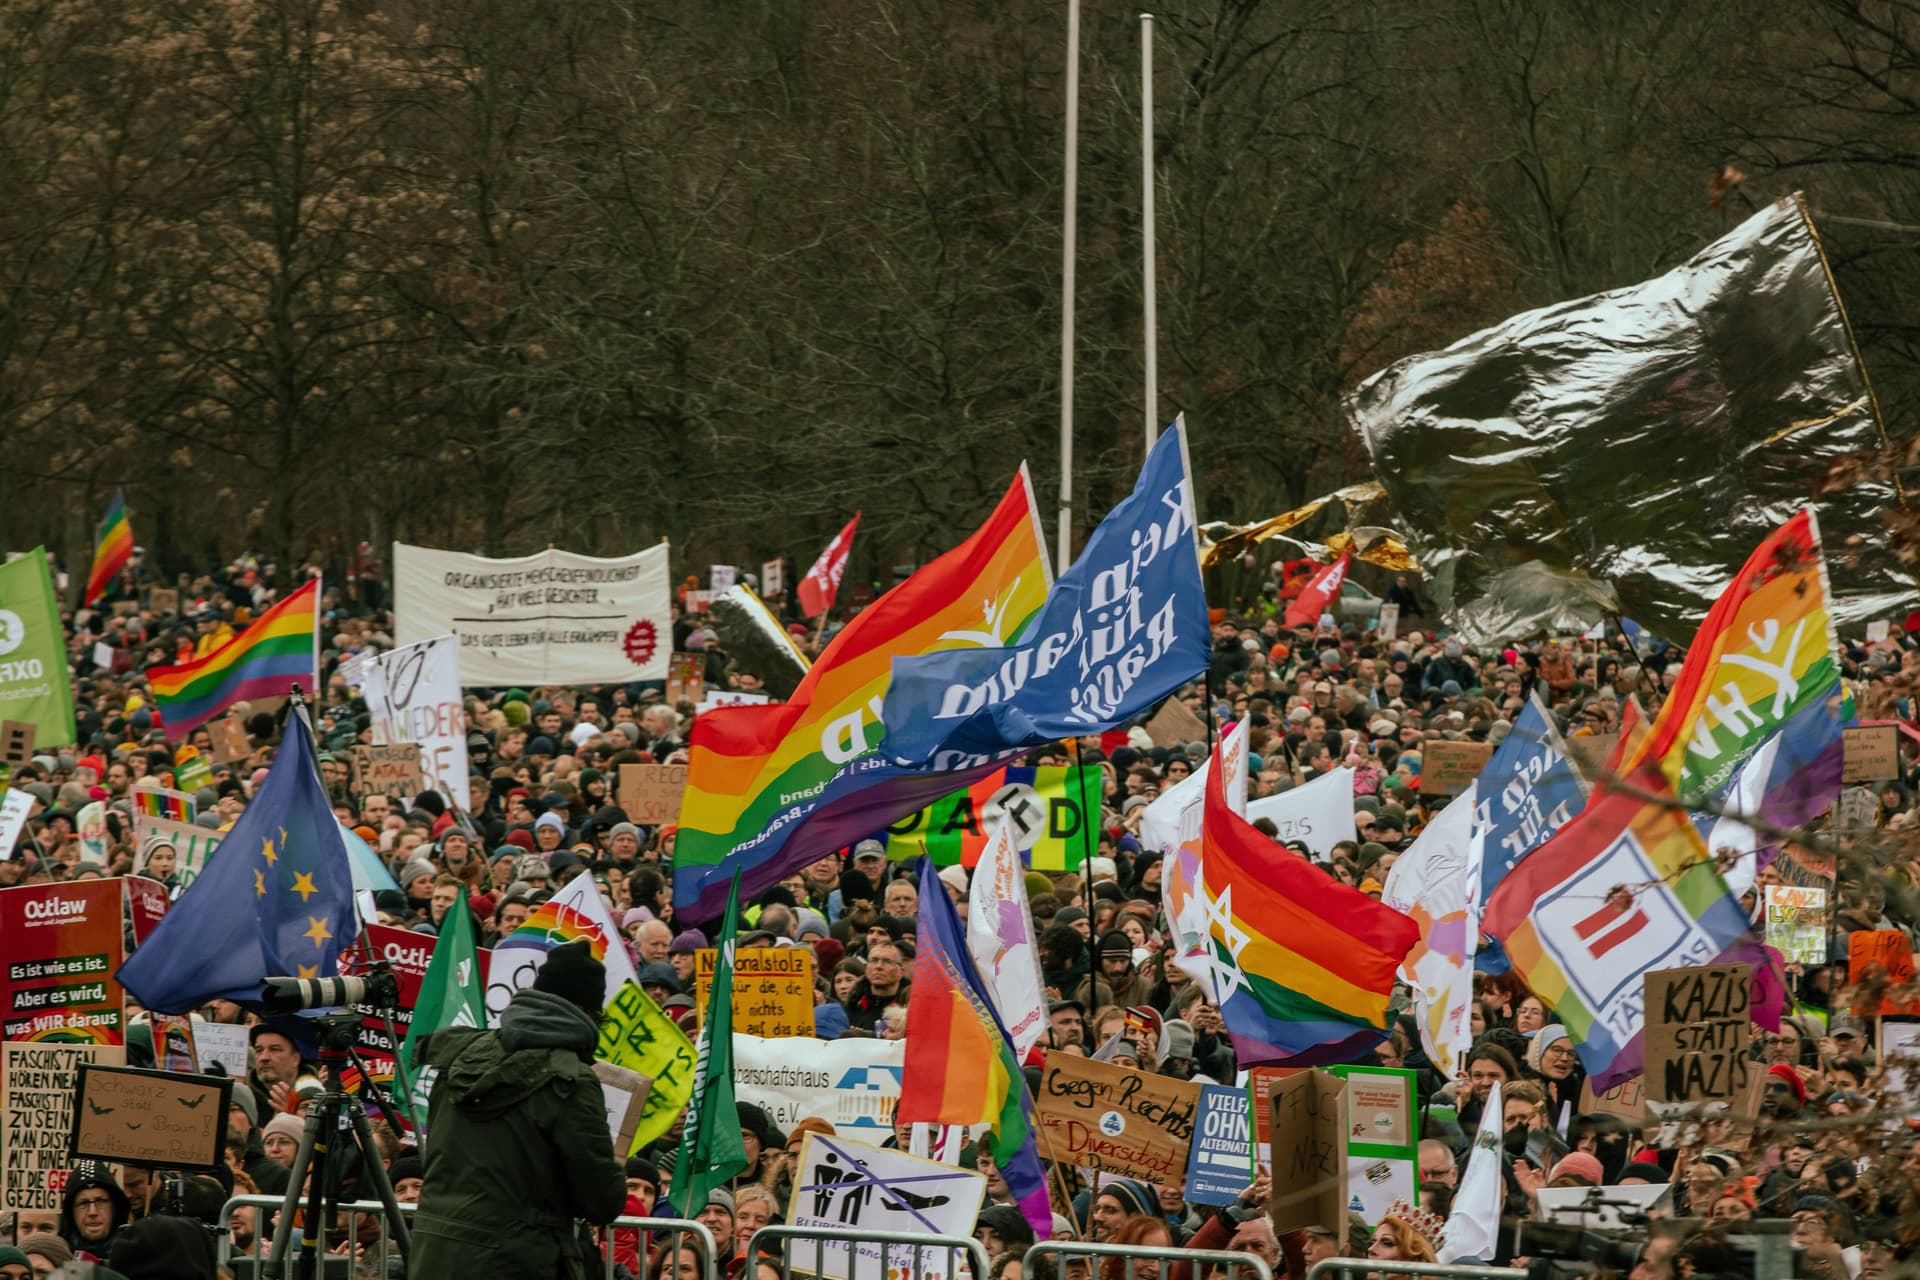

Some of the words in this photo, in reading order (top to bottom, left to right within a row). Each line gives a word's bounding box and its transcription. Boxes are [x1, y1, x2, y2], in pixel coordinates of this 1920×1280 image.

[24, 897, 87, 919] Outlaw
[384, 942, 434, 969] Outla
[702, 949, 804, 973] Nonalstolz
[11, 966, 25, 979] Es
[26, 964, 43, 976] ist
[44, 961, 66, 974] wie
[68, 961, 83, 973] es
[85, 957, 107, 970] ist.
[14, 992, 48, 1009] Aber
[49, 990, 67, 1003] es
[69, 983, 107, 1002] wird,
[5, 1021, 32, 1036] was
[33, 1014, 65, 1031] WIR
[67, 1011, 118, 1028] daraus
[773, 1022, 791, 1036] das
[796, 1023, 814, 1036] sie
[1675, 1021, 1745, 1050] STATT
[9, 1071, 49, 1089] HÖREN
[734, 1065, 830, 1088] barschaftshaus
[1048, 1067, 1113, 1108] Gegen
[1119, 1073, 1195, 1140] Rechts
[8, 1110, 32, 1128] ZU
[35, 1109, 70, 1130] SEIN
[8, 1130, 38, 1148] MAN
[1067, 1120, 1175, 1176] Diversität
[8, 1150, 32, 1169] MIT
[1088, 1153, 1164, 1186] Demokratie
[7, 1169, 24, 1188] HAT
[27, 1170, 44, 1189] DIE
